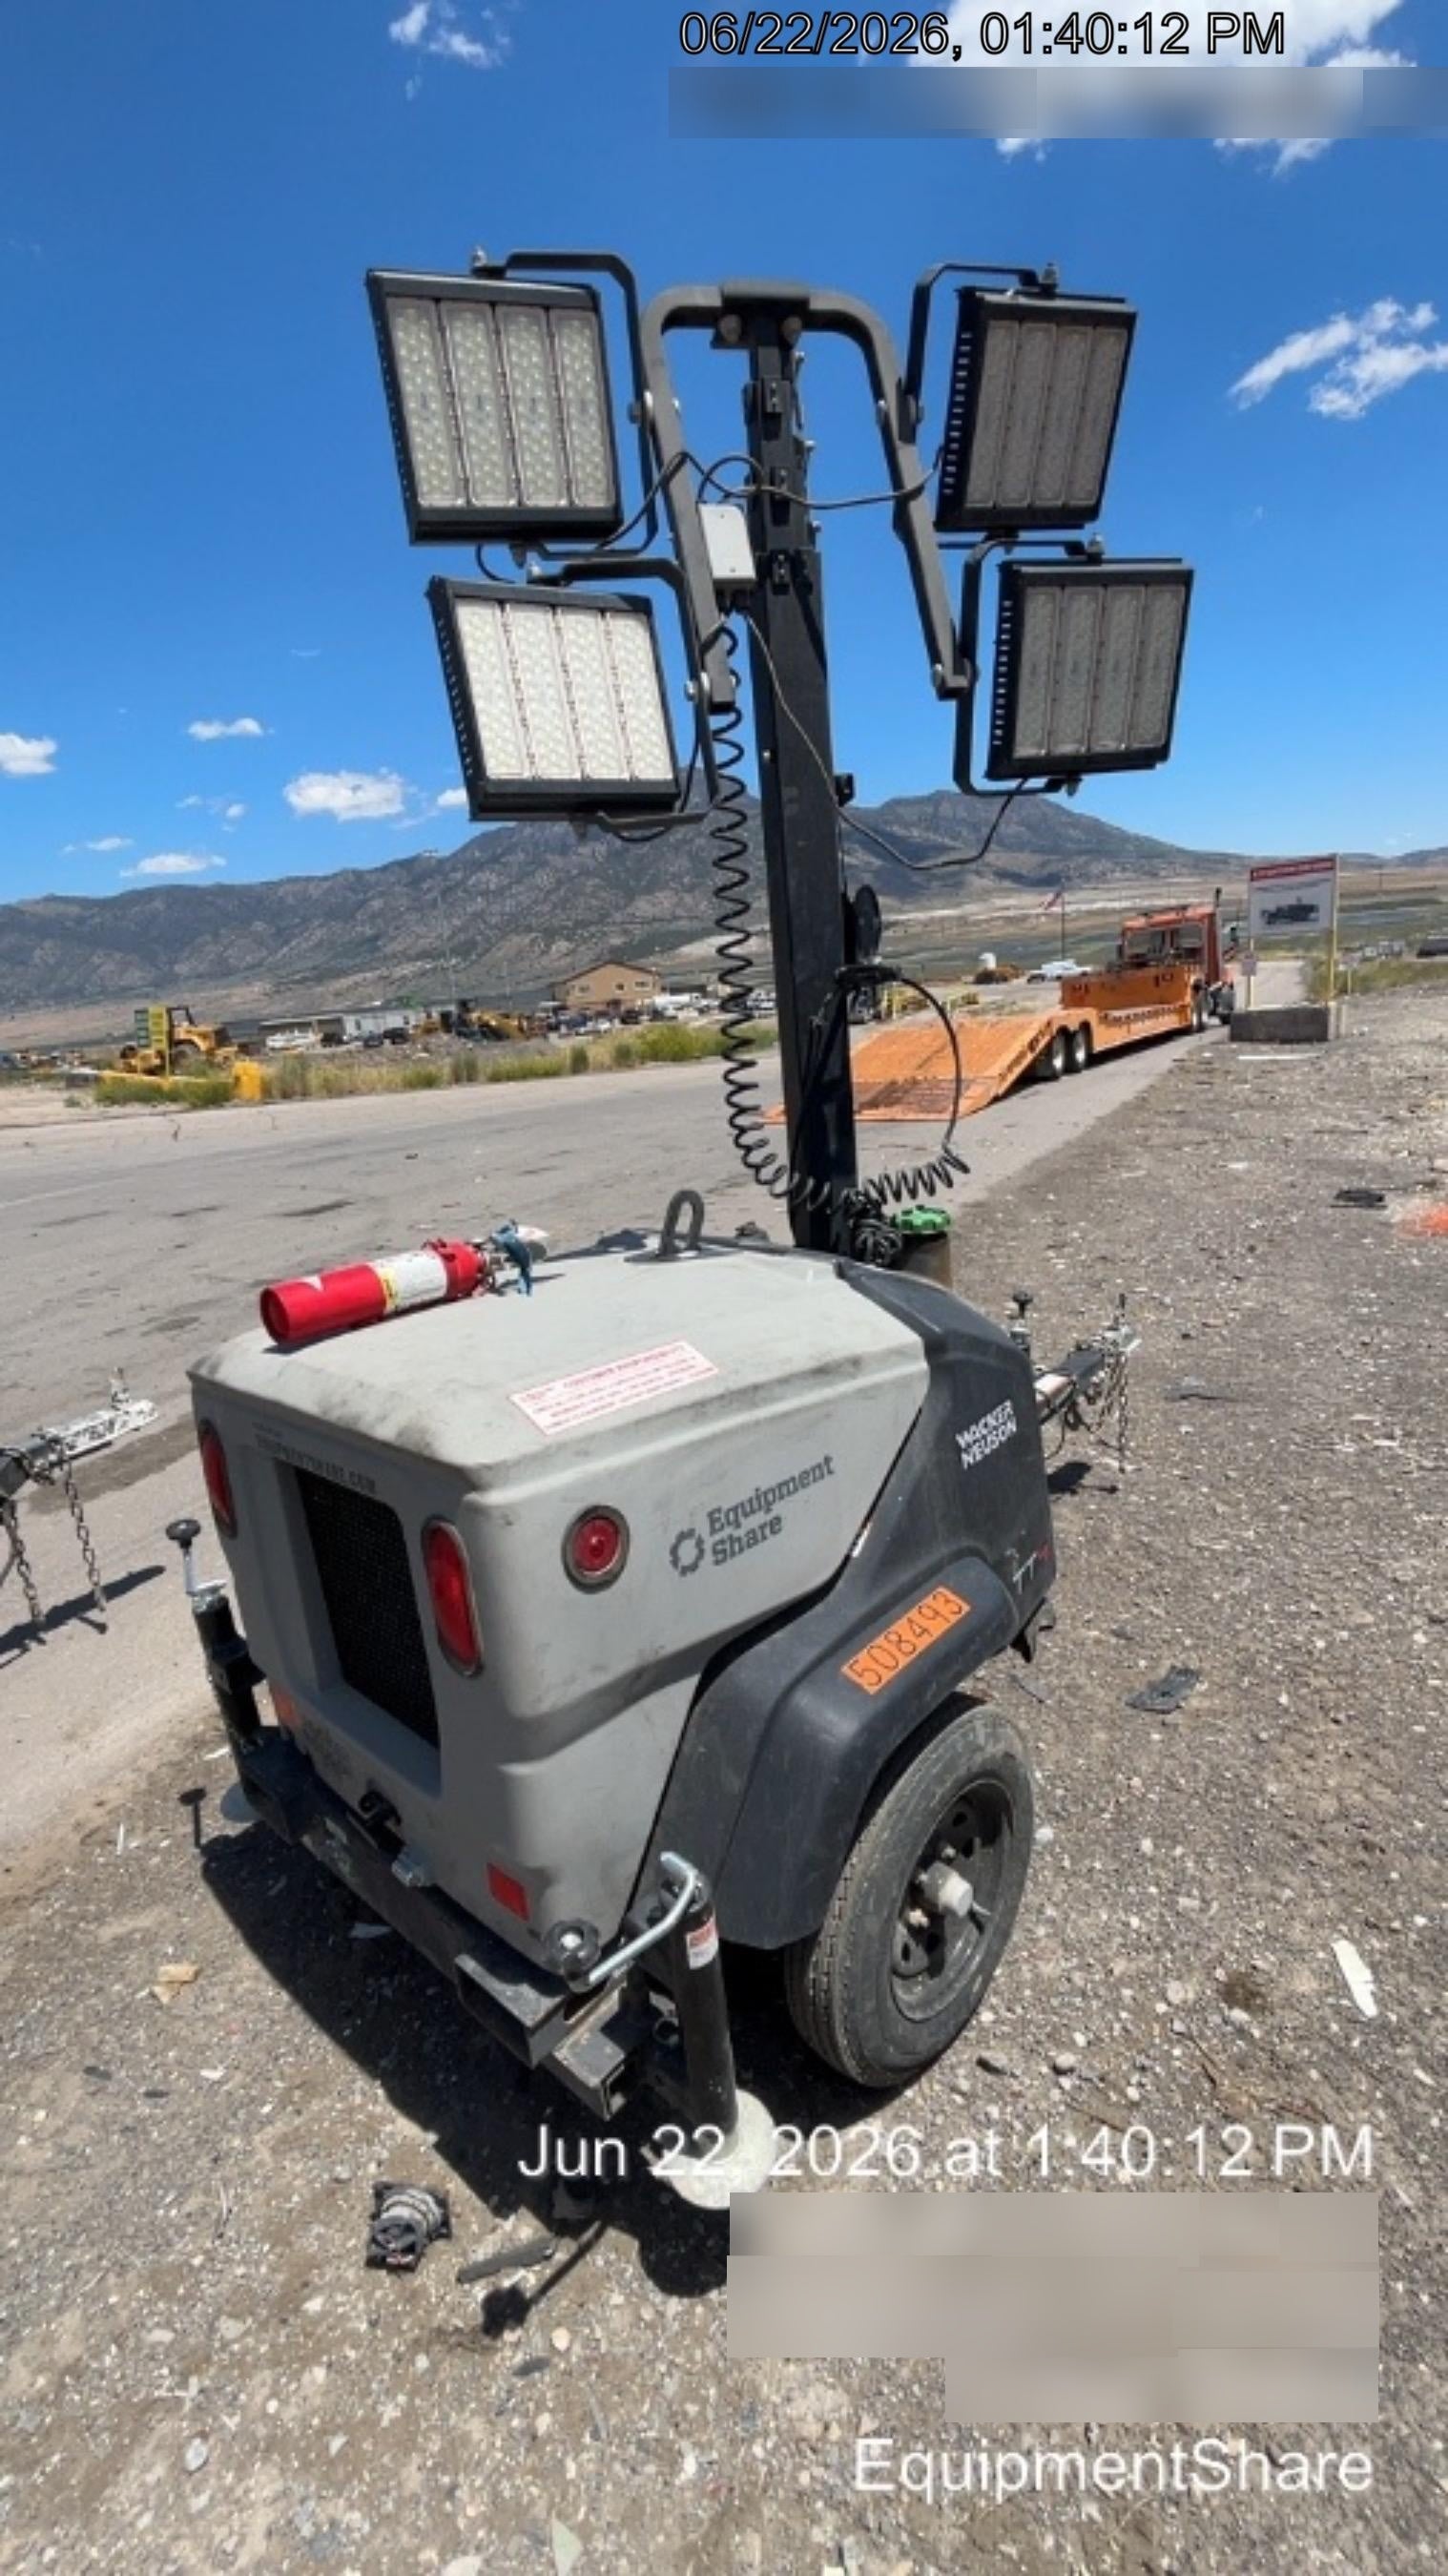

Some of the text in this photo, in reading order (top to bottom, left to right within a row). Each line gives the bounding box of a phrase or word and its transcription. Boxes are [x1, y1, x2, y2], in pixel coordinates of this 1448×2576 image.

[955, 1400, 1013, 1449] WACKER
[961, 1416, 1017, 1470] NEUSON
[707, 1454, 835, 1536] Equipment
[711, 1515, 782, 1566] Share
[849, 1590, 962, 1687] 508493
